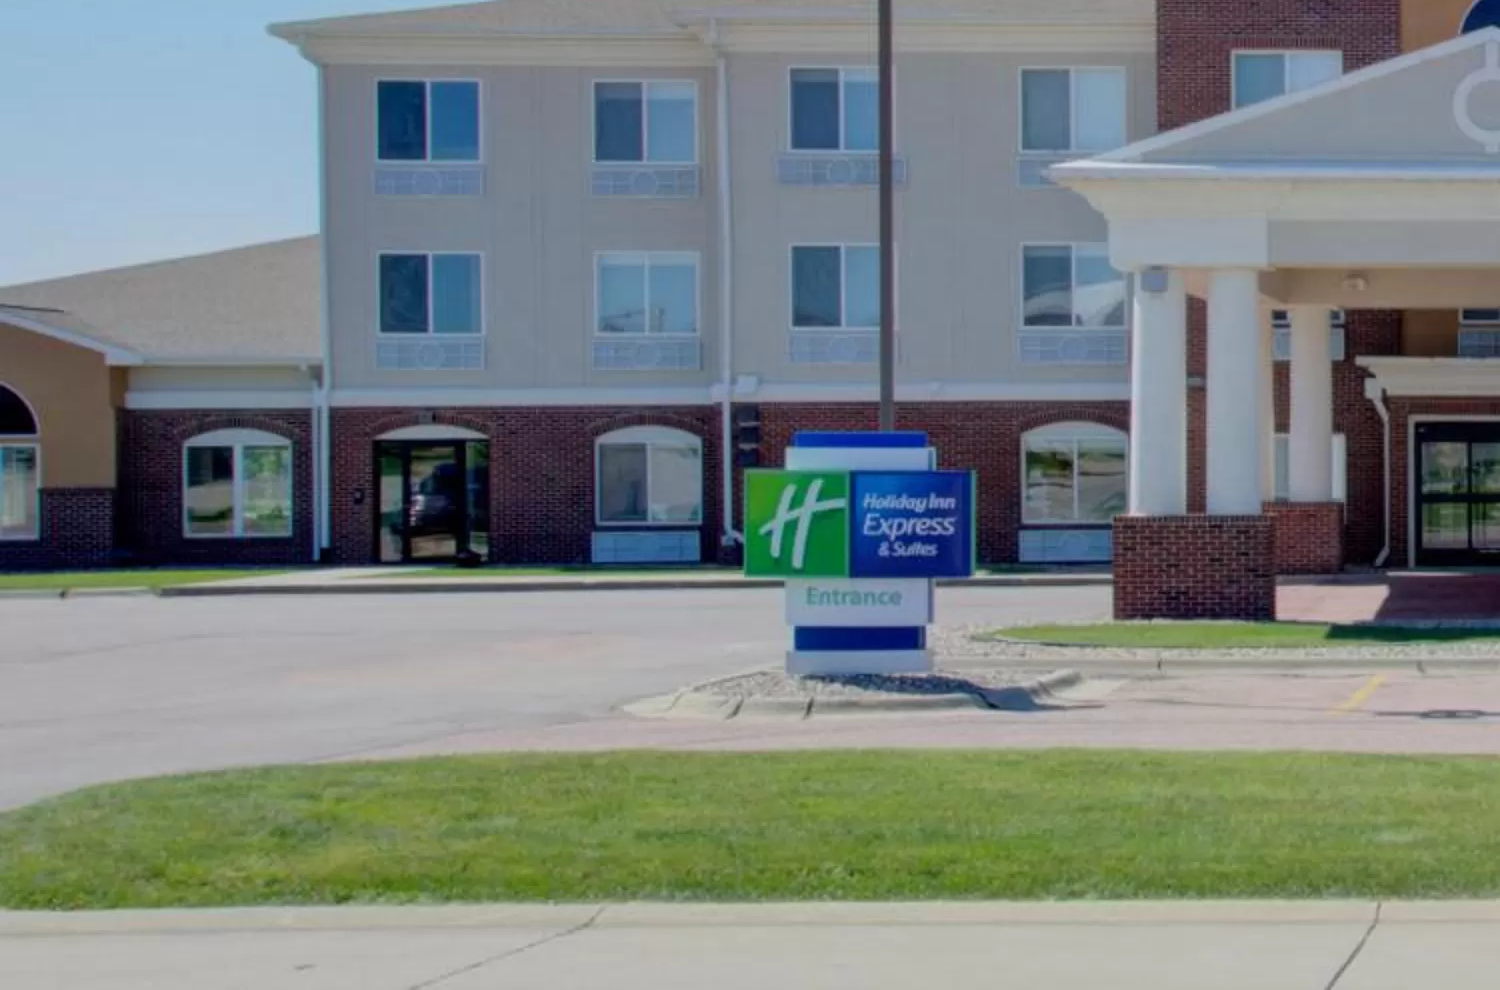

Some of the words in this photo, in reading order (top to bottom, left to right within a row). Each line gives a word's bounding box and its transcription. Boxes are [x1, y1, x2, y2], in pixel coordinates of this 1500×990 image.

[863, 493, 925, 513] Holiday
[928, 493, 956, 508] Inn
[863, 513, 956, 540] Express
[878, 543, 890, 557] &
[892, 542, 939, 557] Suites
[806, 587, 902, 606] Entrance
